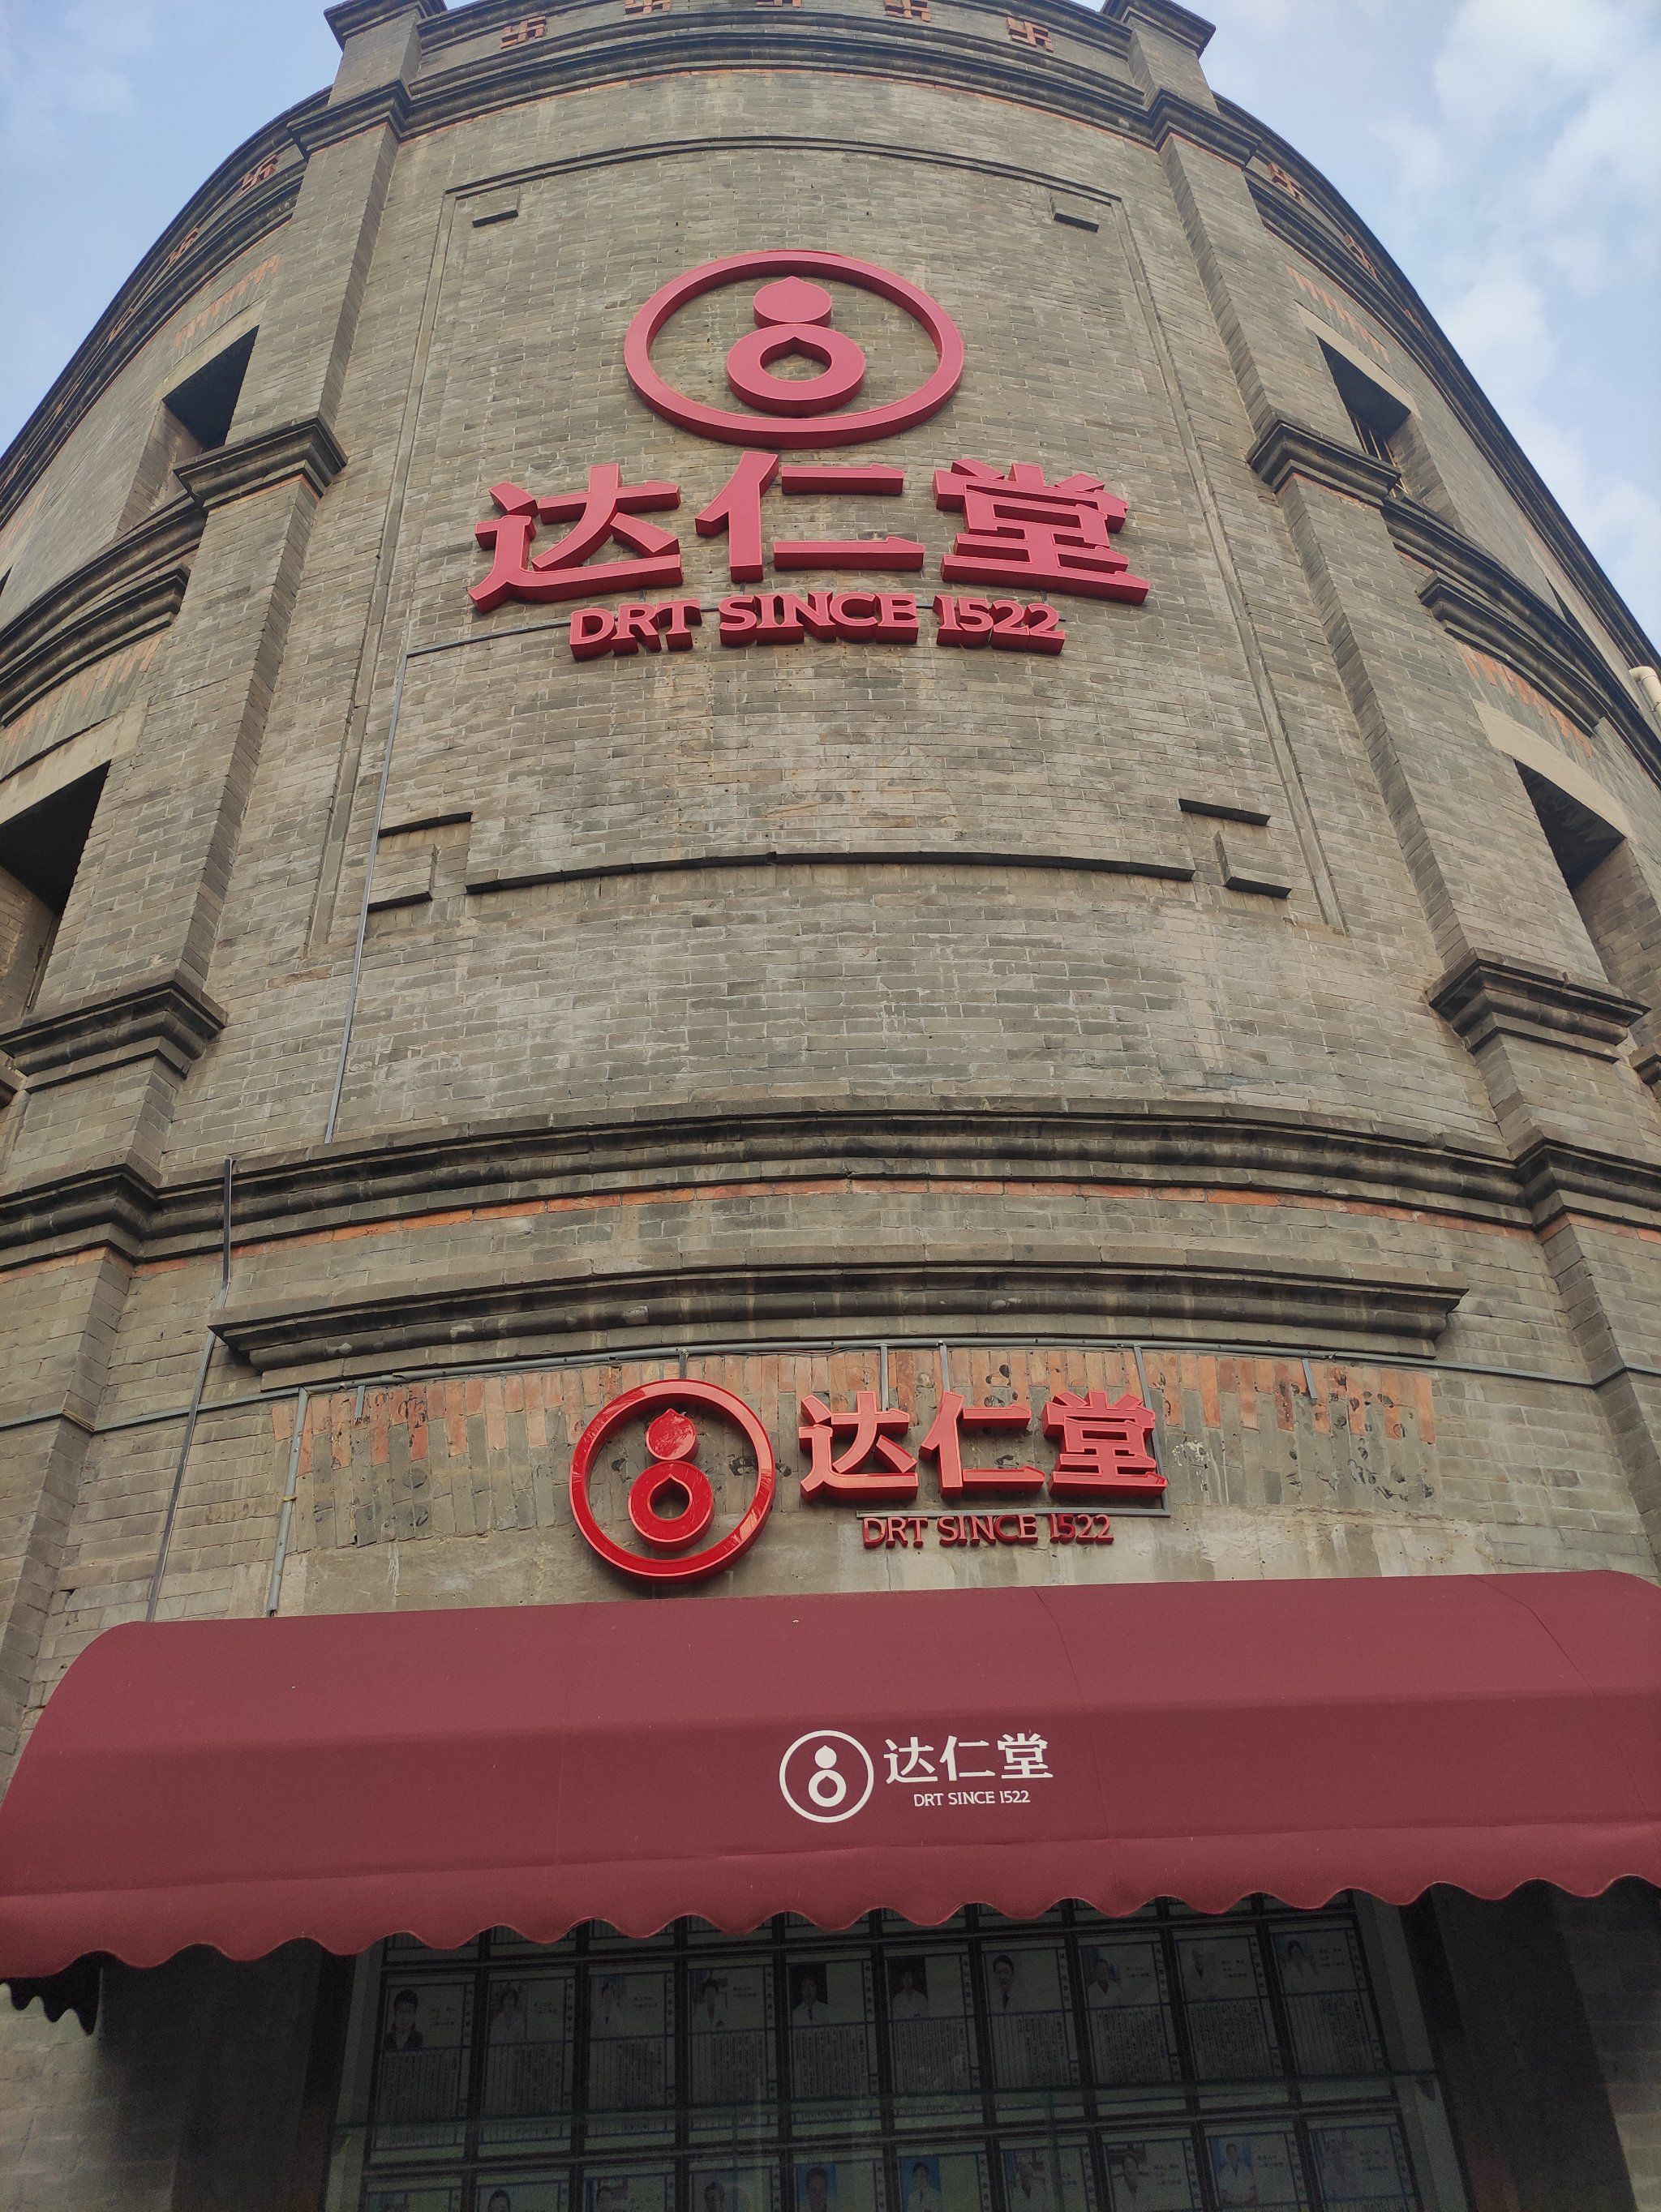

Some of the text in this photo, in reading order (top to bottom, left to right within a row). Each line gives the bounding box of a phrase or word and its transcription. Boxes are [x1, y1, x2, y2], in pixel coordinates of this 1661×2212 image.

[466, 450, 1151, 614] 达仁堂
[569, 590, 1067, 660] DRT SINCE 1522
[799, 1390, 1169, 1501] 达仁堂
[863, 1513, 1114, 1550] DRT SINCE 1522
[883, 1732, 1054, 1784] 达仁堂
[913, 1790, 1030, 1807] DRT SINCE 1522
